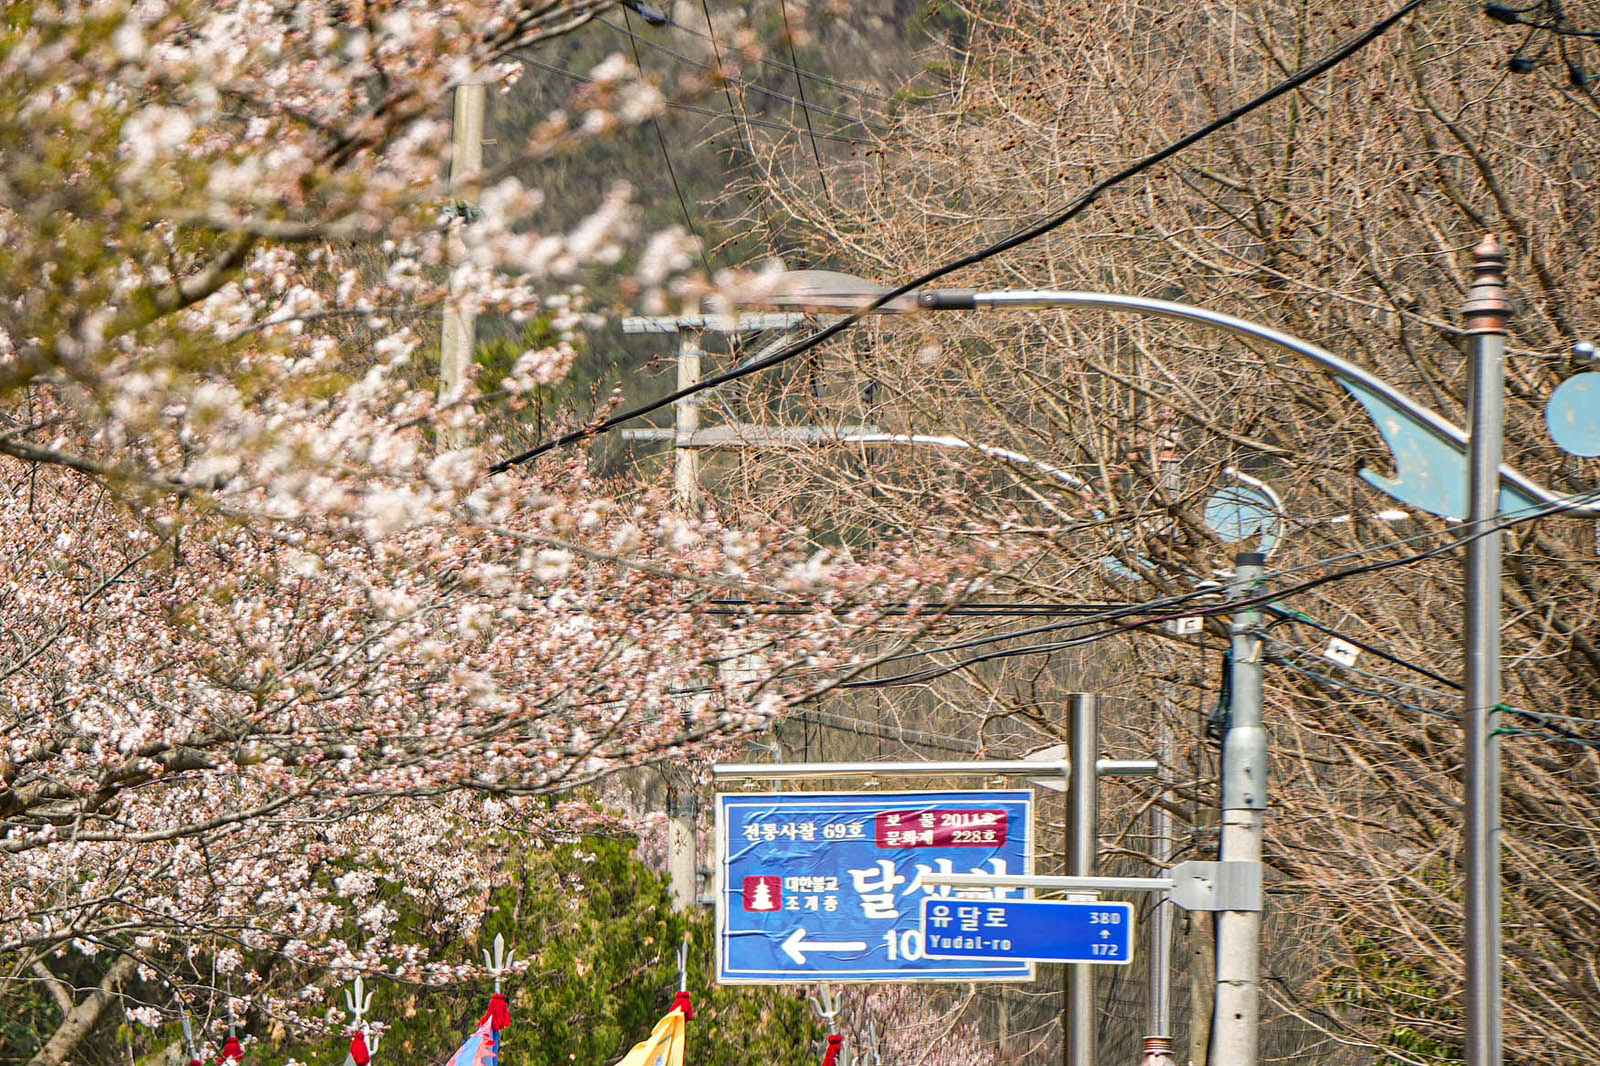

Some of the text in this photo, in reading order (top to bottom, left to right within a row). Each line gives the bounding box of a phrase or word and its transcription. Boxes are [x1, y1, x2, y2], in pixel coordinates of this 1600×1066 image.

[743, 822, 866, 841] 전통사찰 69호
[884, 829, 998, 845] 문화재 228호
[784, 876, 840, 893] 대한불교
[784, 895, 839, 912] 조계종
[929, 904, 1009, 932] 유달로
[1088, 911, 1121, 925] 380
[882, 929, 923, 961] 10
[929, 934, 1012, 951] Yudal-ro
[1090, 943, 1119, 956] 172
